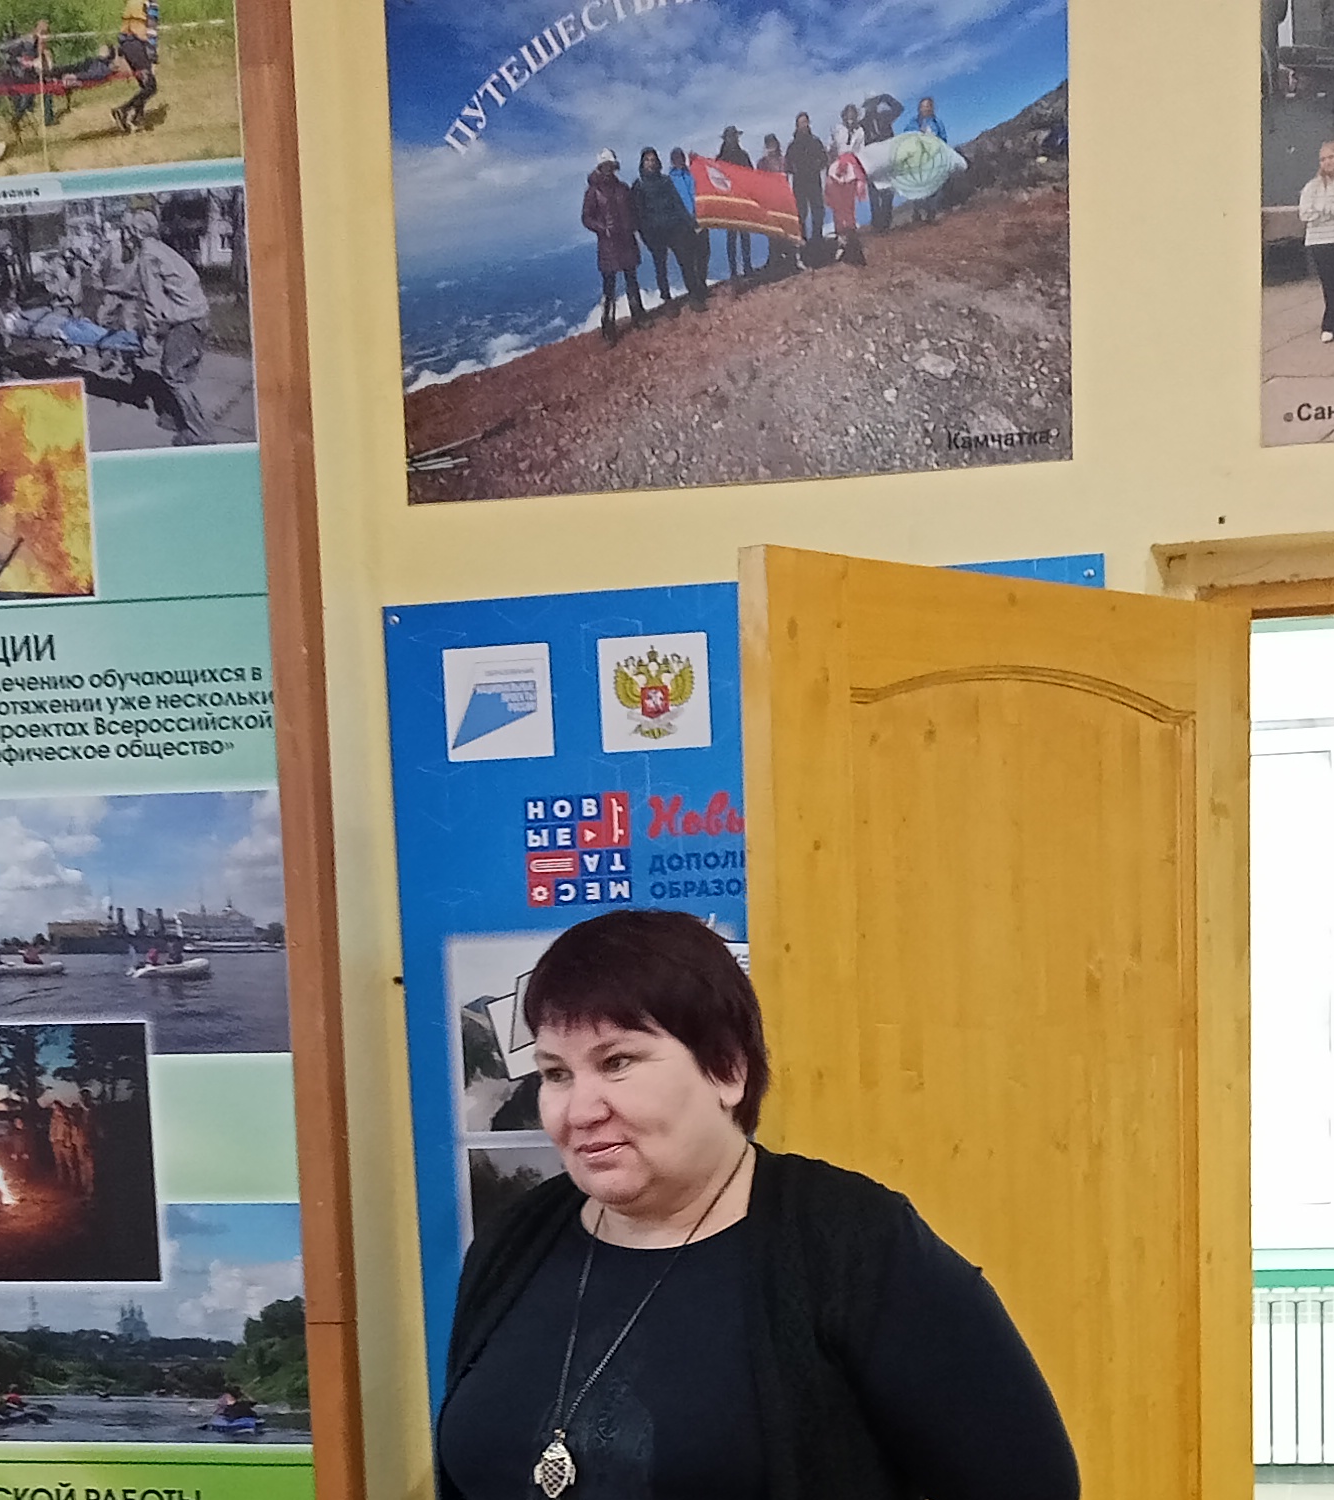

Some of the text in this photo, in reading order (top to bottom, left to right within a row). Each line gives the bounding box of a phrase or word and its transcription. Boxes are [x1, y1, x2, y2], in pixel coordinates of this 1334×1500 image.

[946, 427, 1054, 452] Камчатка
[89, 666, 246, 691] обучающихся
[252, 667, 262, 681] в
[105, 693, 151, 715] уже
[93, 710, 272, 735] Всероссийской
[117, 739, 235, 760] общество»
